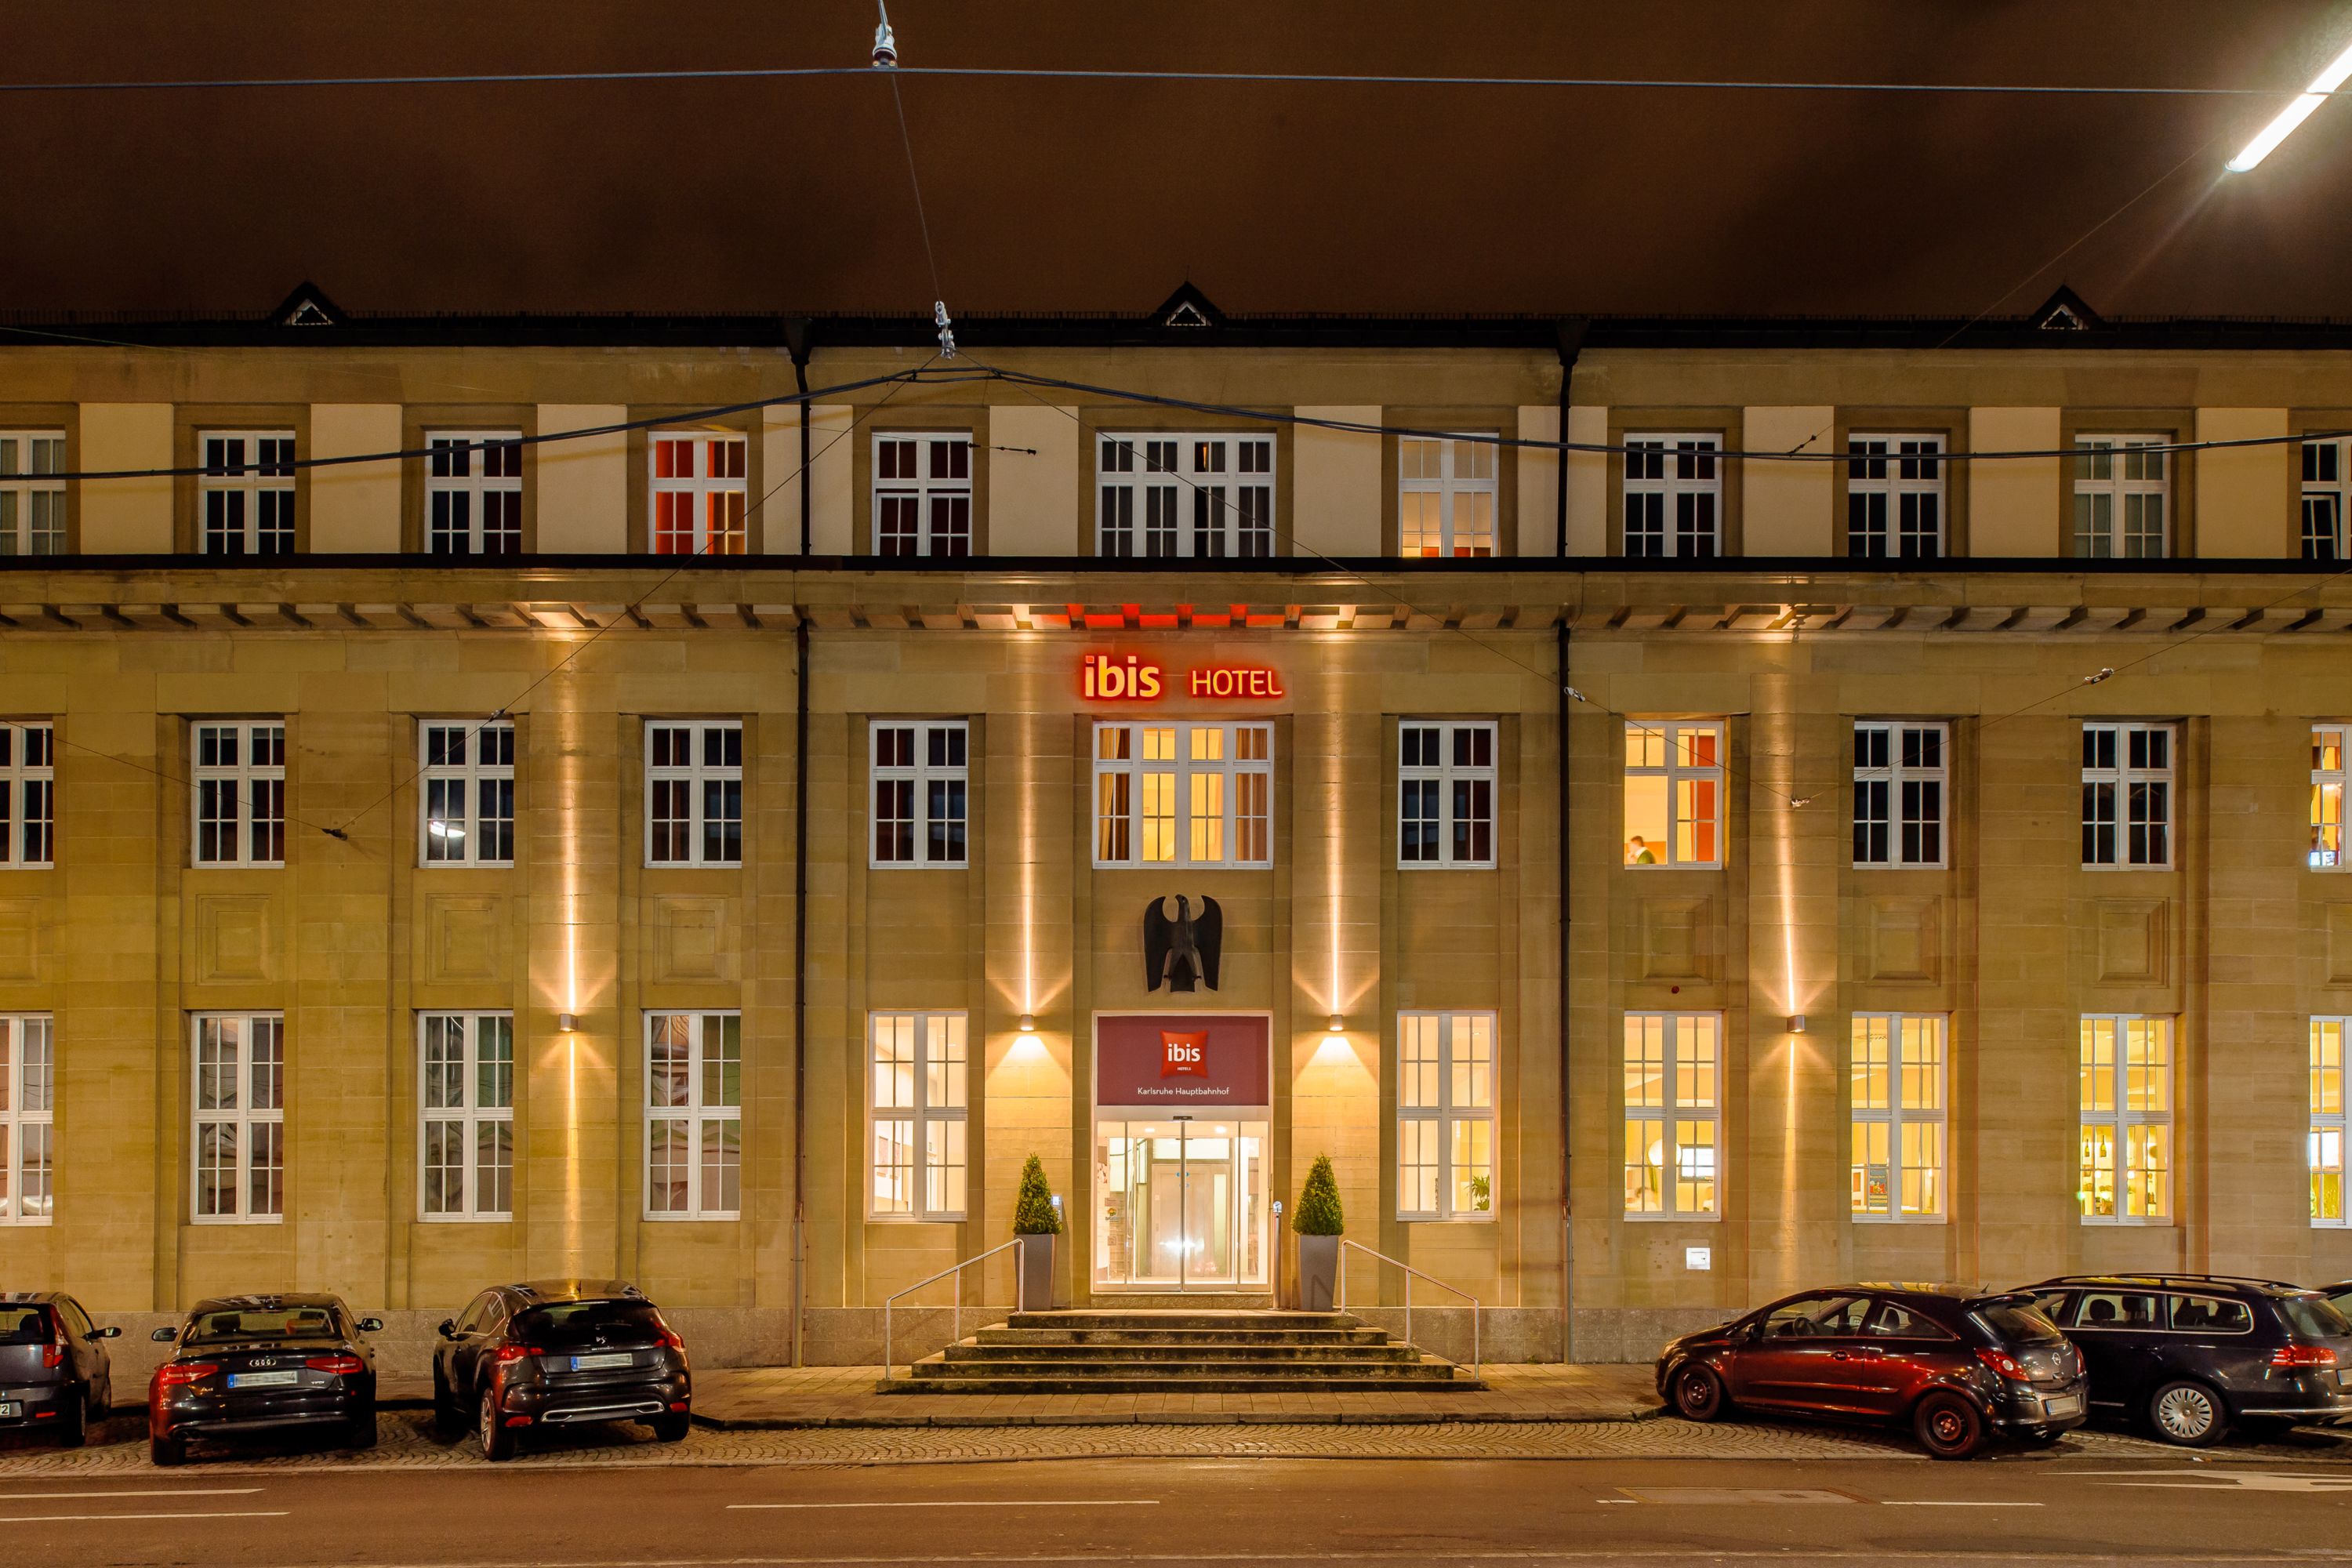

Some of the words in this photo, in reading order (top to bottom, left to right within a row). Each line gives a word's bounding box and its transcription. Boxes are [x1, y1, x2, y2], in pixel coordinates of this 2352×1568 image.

[1084, 655, 1160, 697] ibis
[1192, 670, 1283, 695] HOTEL
[1167, 1043, 1201, 1062] ibis
[1138, 1087, 1174, 1095] Karlsruhe
[1175, 1087, 1229, 1097] Hauptbahnhof
